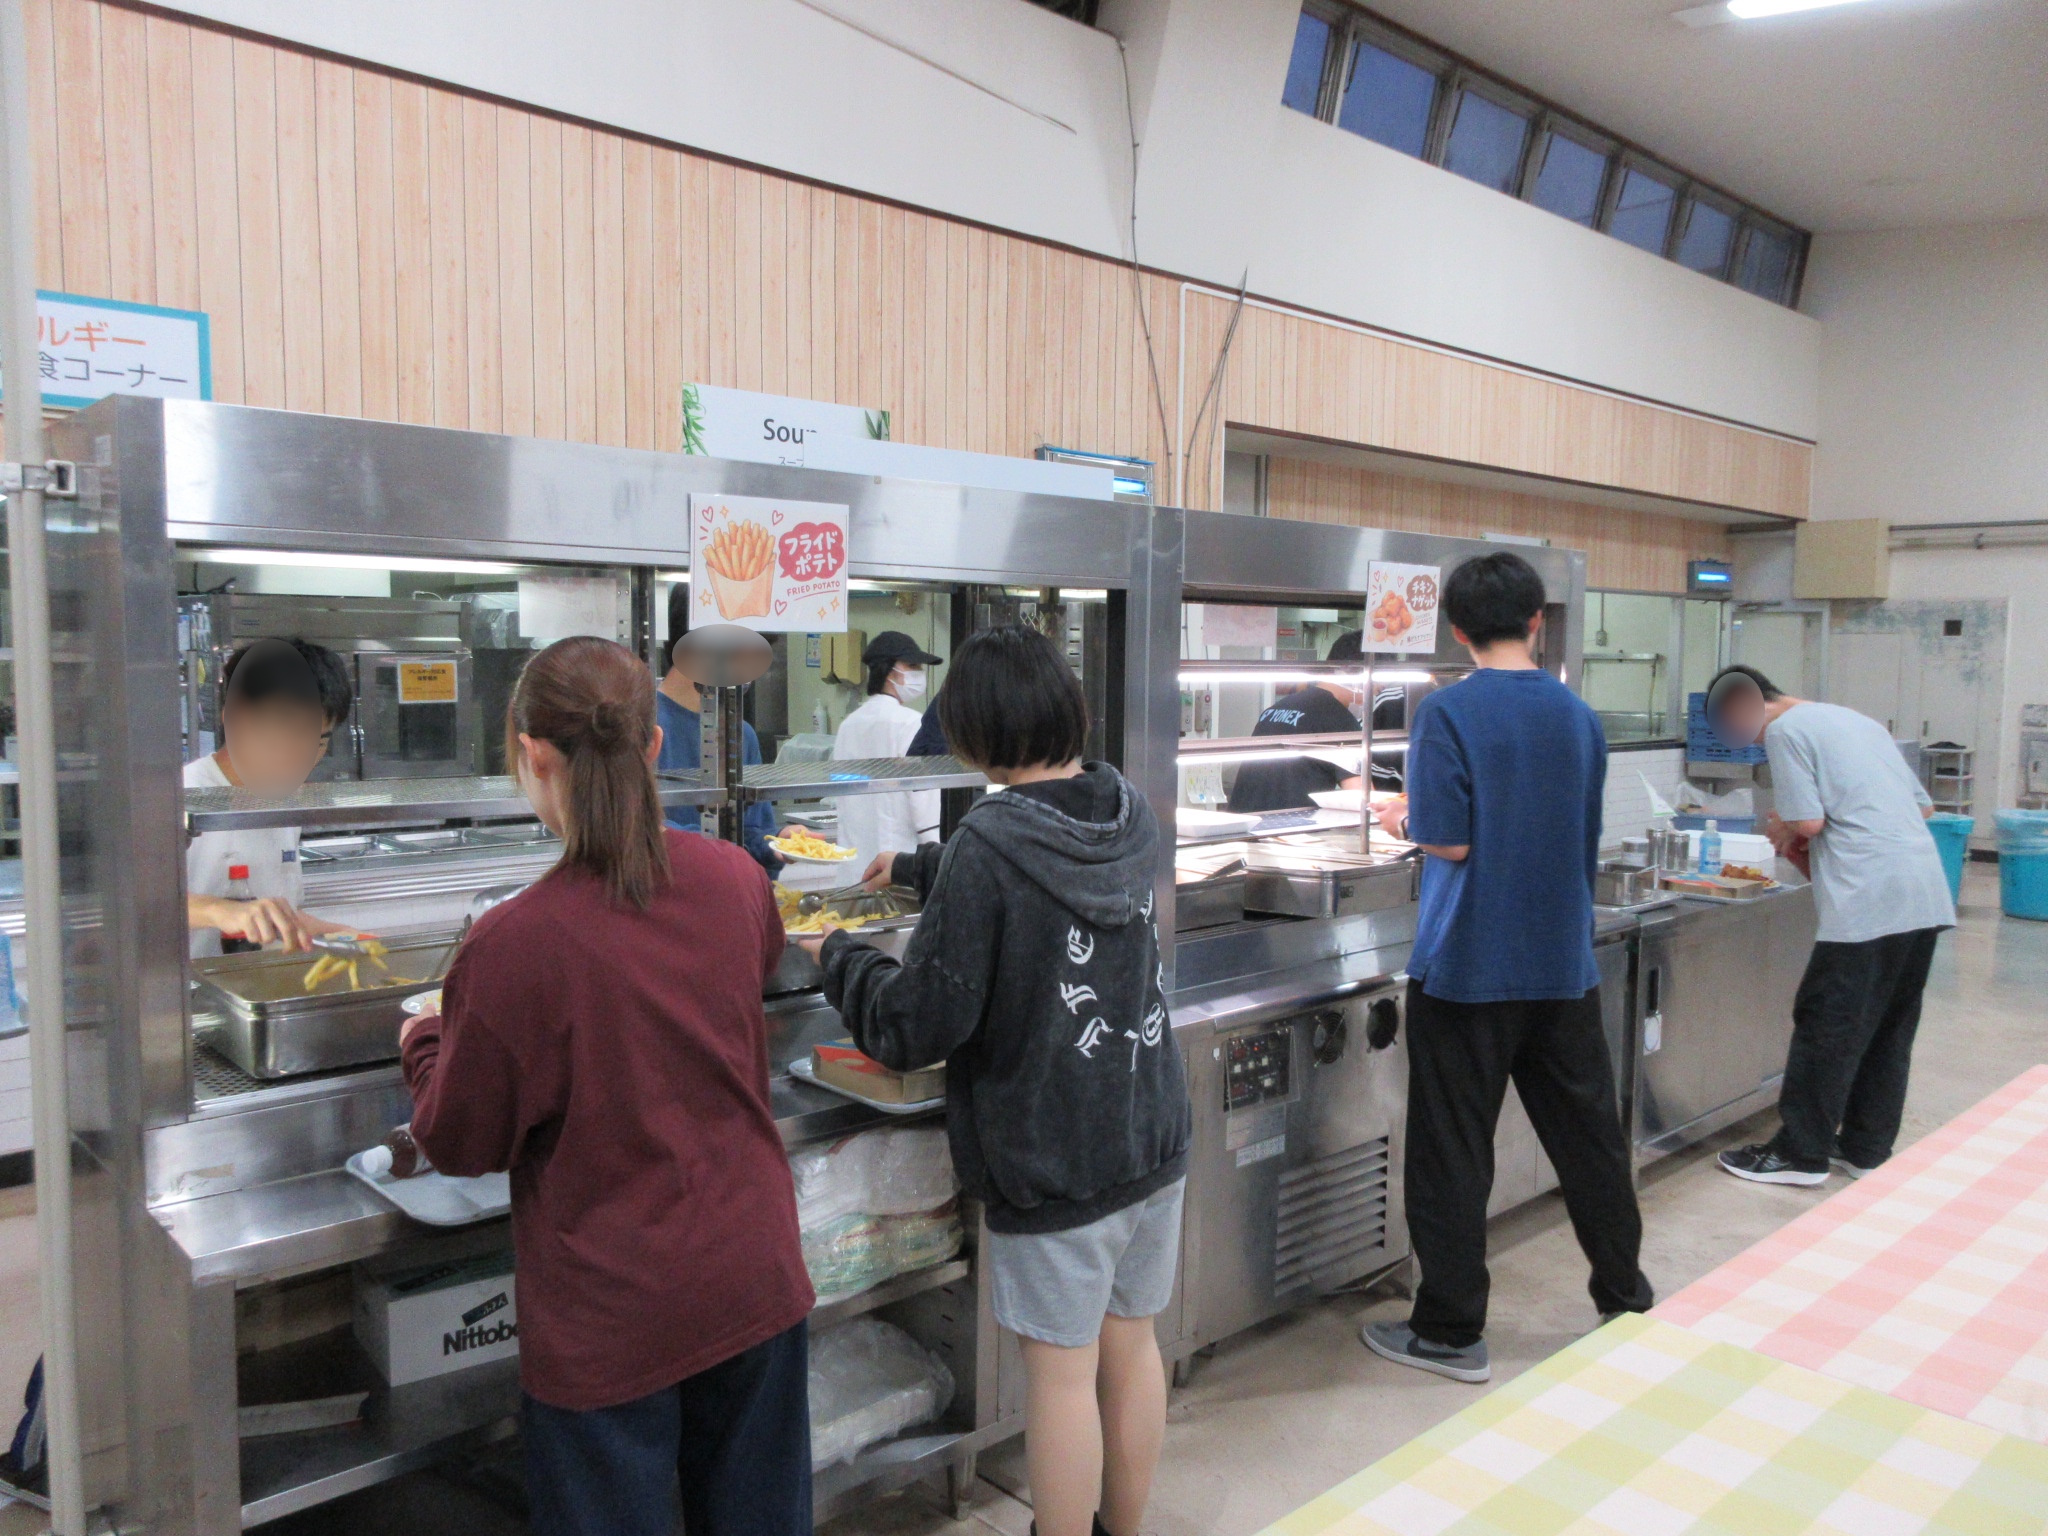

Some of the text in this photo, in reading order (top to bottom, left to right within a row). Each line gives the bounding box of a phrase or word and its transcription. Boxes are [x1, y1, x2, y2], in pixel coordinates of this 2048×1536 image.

[763, 418, 817, 445] Sou
[784, 531, 838, 556] フライド
[795, 551, 838, 576] ポテト
[786, 580, 841, 597] FRIED POTATO
[1412, 580, 1434, 594] チキン
[1411, 594, 1436, 608] ナゲット
[1270, 708, 1306, 727] YONEX
